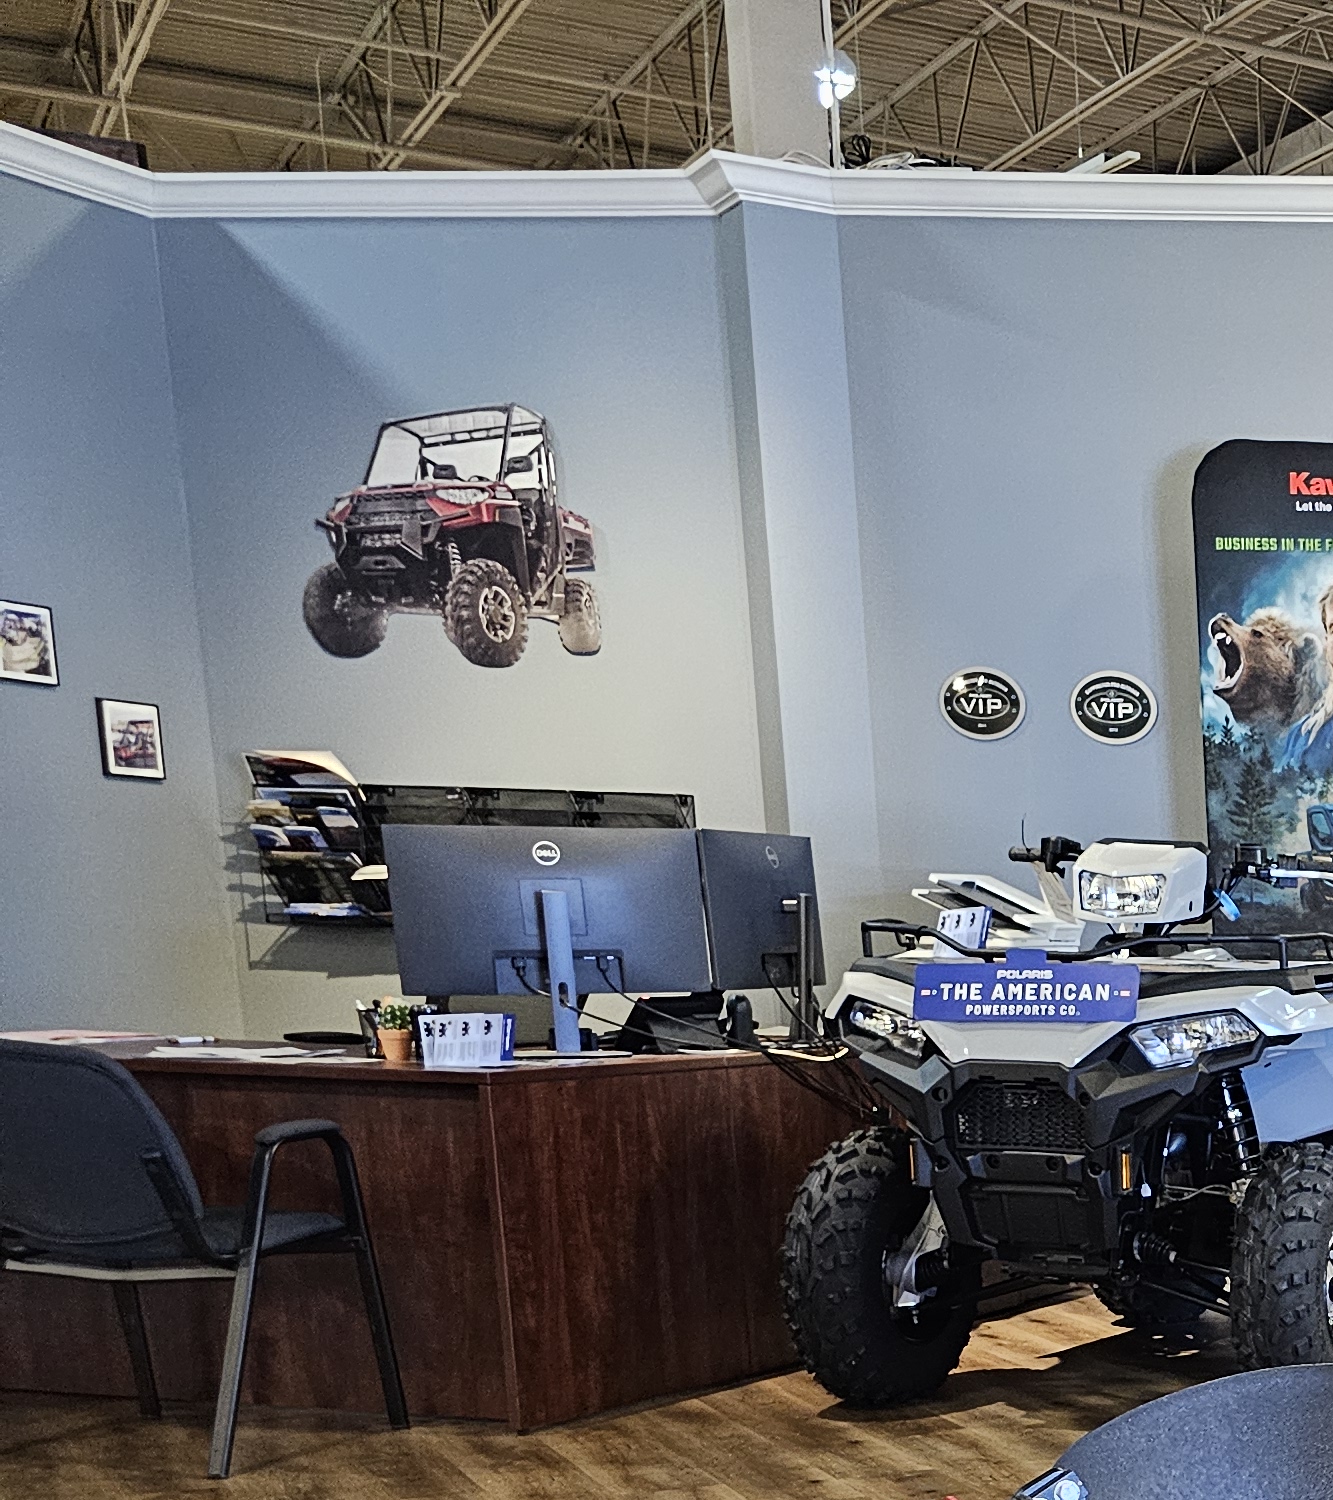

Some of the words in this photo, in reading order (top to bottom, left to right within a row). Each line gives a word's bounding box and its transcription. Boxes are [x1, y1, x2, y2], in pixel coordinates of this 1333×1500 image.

[1296, 501, 1312, 511] Let
[1315, 502, 1331, 512] the
[1215, 537, 1278, 551] BUSINESS
[1281, 538, 1294, 551] IN
[1298, 538, 1322, 552] THE
[960, 698, 1002, 714] VIP
[1090, 701, 1134, 719] VIP
[996, 969, 1054, 979] POLARIS
[940, 983, 982, 1001] THE
[990, 983, 1111, 1001] AMERICAN
[965, 1004, 1056, 1016] POWERSPORTS
[1059, 1005, 1081, 1017] CO.
